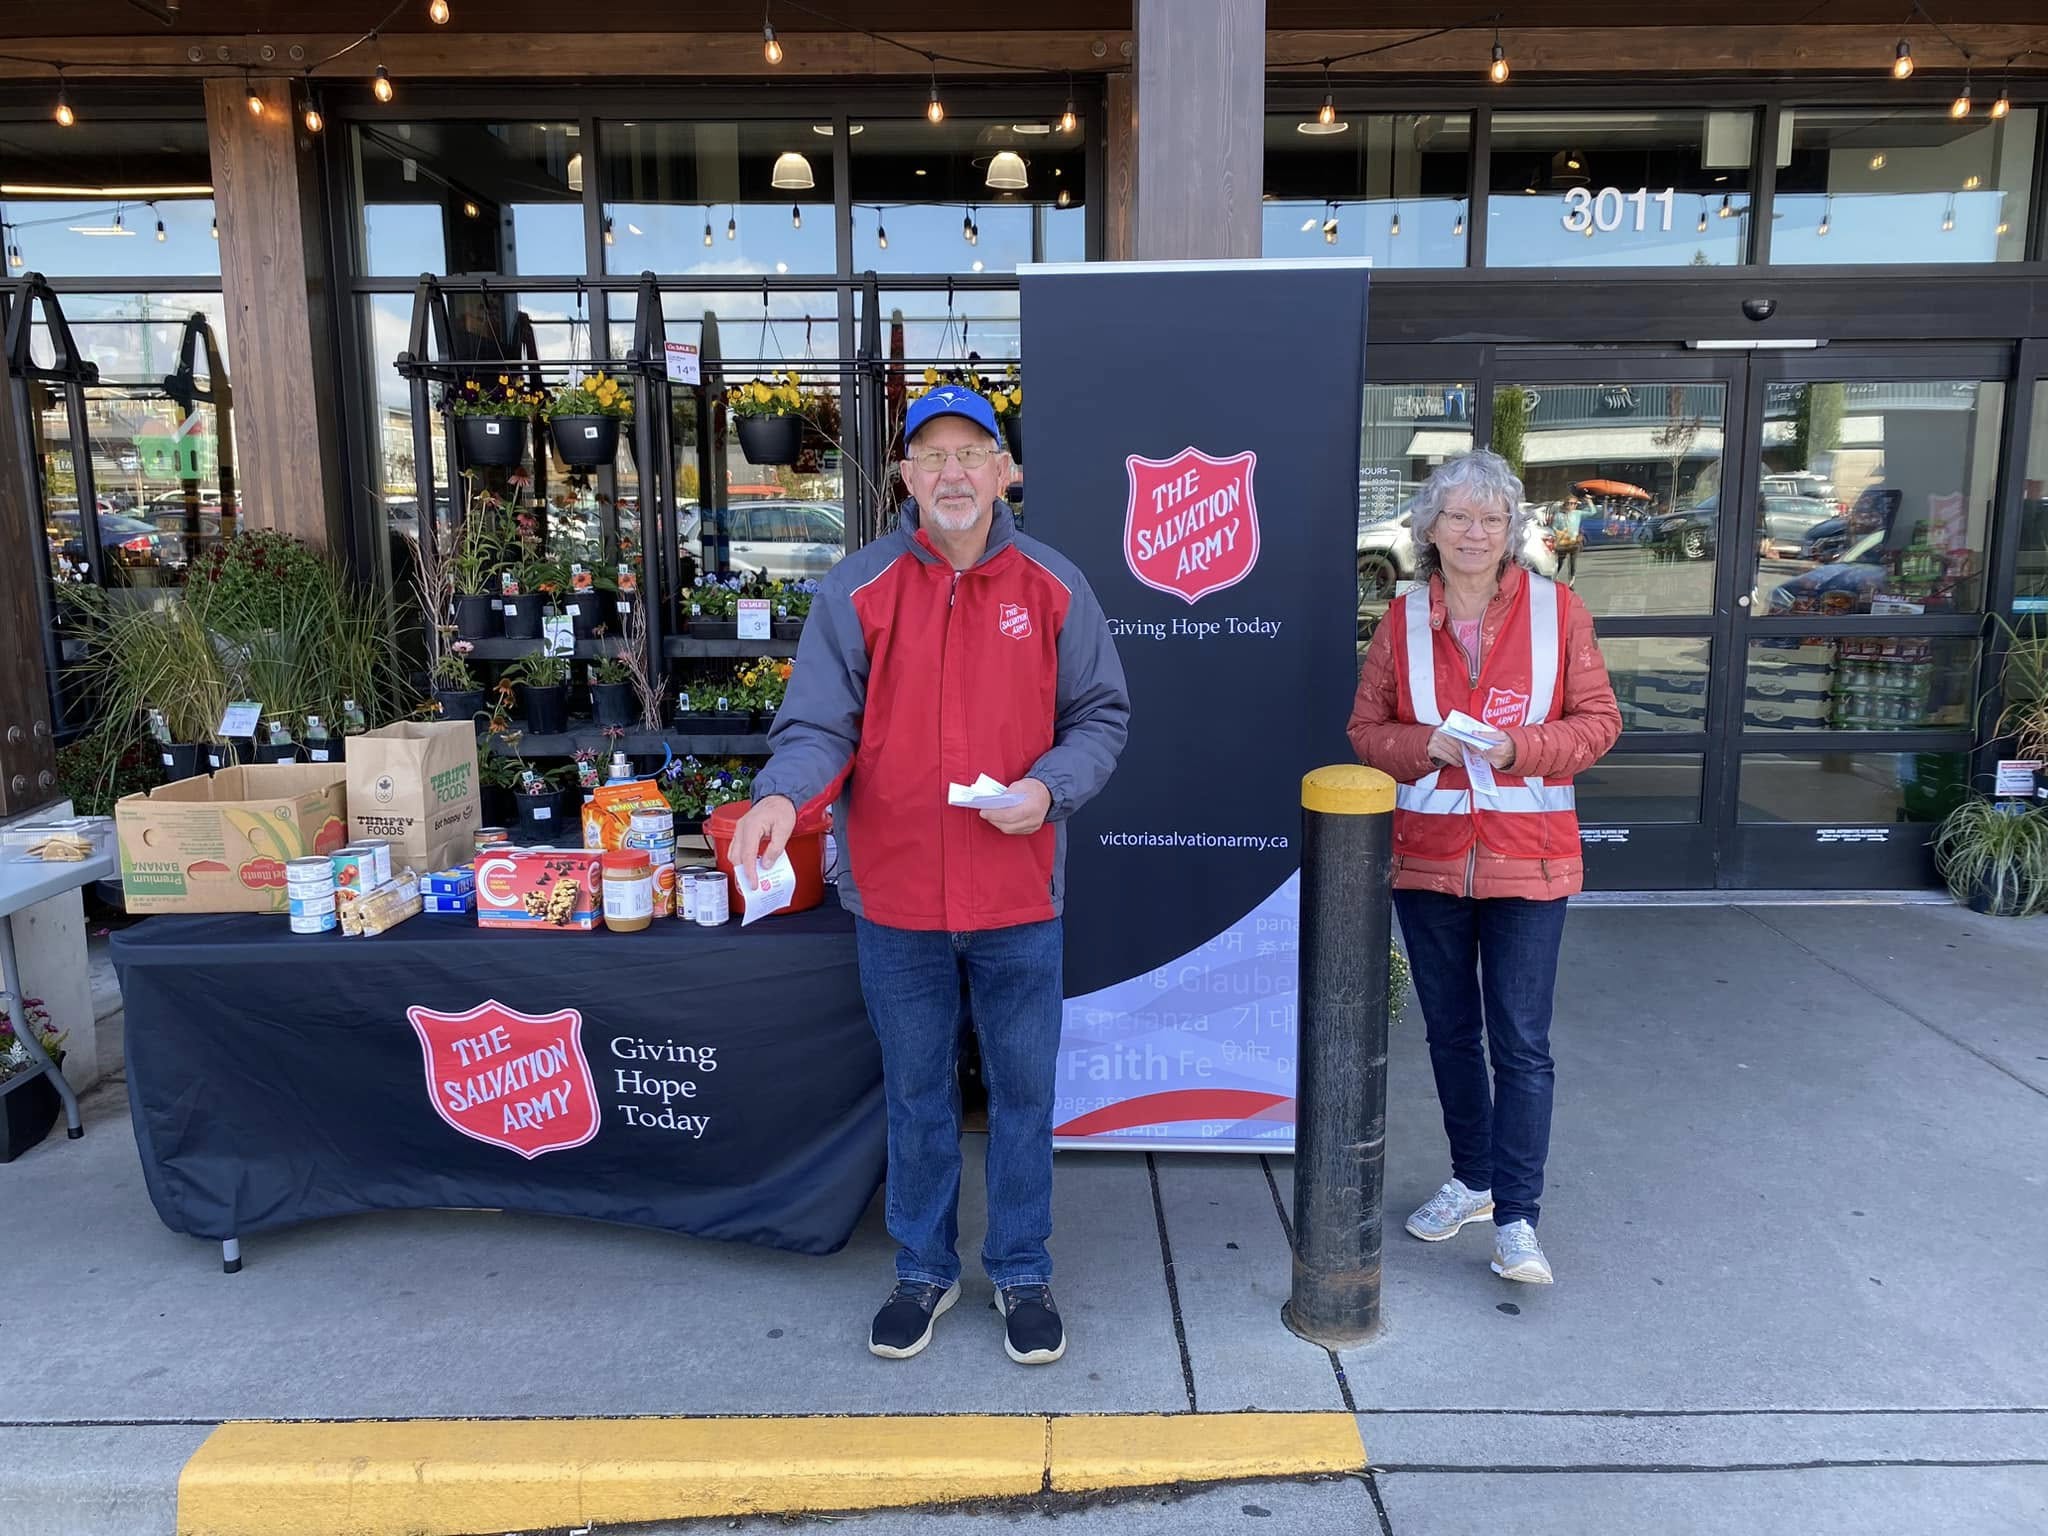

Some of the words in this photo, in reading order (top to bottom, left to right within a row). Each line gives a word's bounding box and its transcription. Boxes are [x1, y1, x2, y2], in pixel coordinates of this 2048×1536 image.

[1563, 187, 1675, 231] 3011
[1152, 468, 1200, 514] THE
[1137, 477, 1241, 560] SALVATION
[1175, 518, 1240, 580] ARMY
[1005, 608, 1018, 618] THE
[1012, 621, 1028, 635] ARMY
[1106, 618, 1166, 640] Giving
[1172, 618, 1220, 640] Hope
[1225, 617, 1282, 639] Today
[1495, 695, 1512, 707] THE
[1496, 713, 1521, 726] ARMY
[430, 761, 471, 791] THRIFTY
[437, 781, 468, 803] FOODS
[357, 816, 414, 826] THRIFTY
[367, 825, 405, 836] FOODS
[1100, 831, 1289, 851] victoriasalvationarmy.ca
[1179, 966, 1292, 994] Glaube
[1069, 1006, 1209, 1036] Esperanza
[451, 1025, 512, 1068] THE
[610, 1036, 718, 1072] Giving
[444, 1037, 569, 1112] SALVATION
[1068, 1044, 1168, 1081] Faith
[1179, 1051, 1213, 1077] Fe
[614, 1069, 697, 1104] Hope
[503, 1079, 572, 1134] ARMY
[618, 1105, 711, 1139] Today
